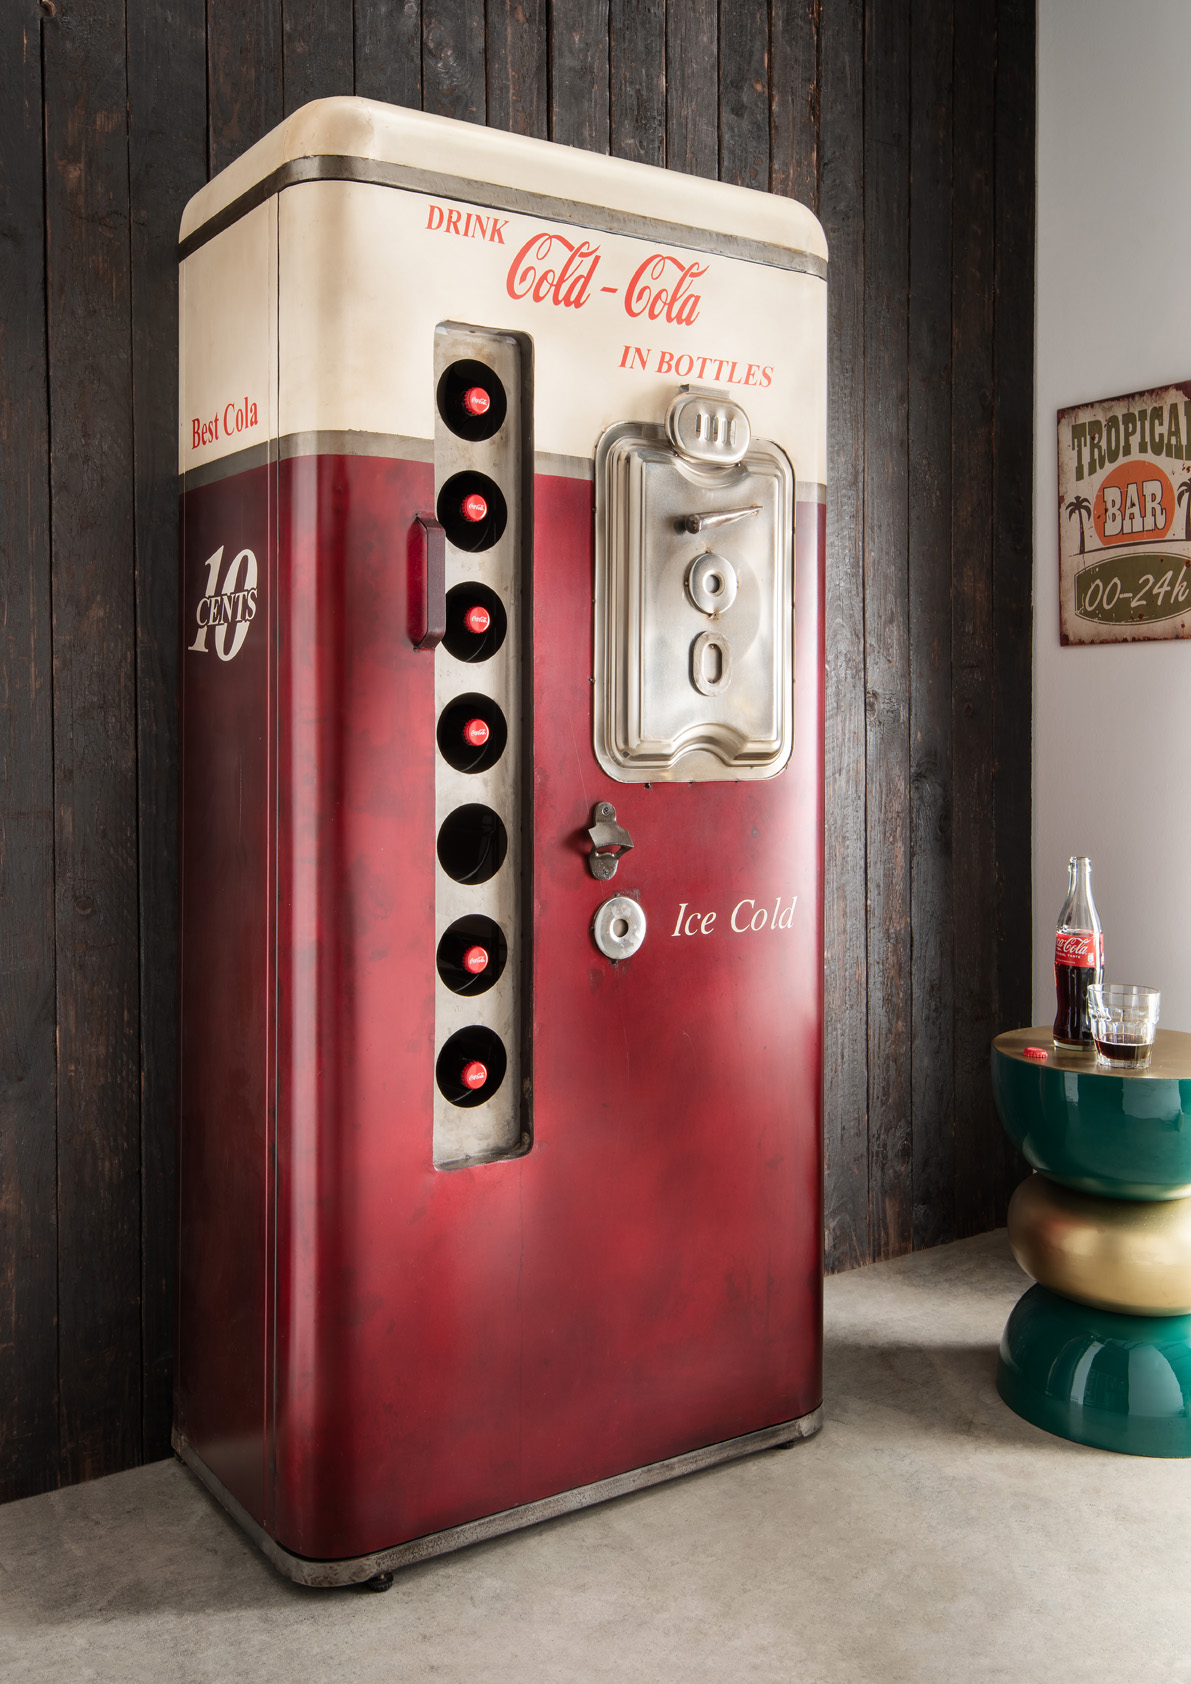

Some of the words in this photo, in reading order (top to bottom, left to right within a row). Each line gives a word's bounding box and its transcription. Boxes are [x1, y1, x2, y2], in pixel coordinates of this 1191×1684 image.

[425, 204, 510, 245] DRINK
[618, 344, 652, 370] IN
[655, 350, 775, 388] BOTTLES
[191, 411, 220, 450] Best
[223, 396, 259, 437] Cola
[1102, 479, 1167, 538] BAR
[188, 545, 258, 662] 10
[196, 588, 258, 627] CENTS
[1084, 565, 1190, 612] 00-24h
[671, 903, 717, 937] Ice
[730, 896, 798, 933] Cold
